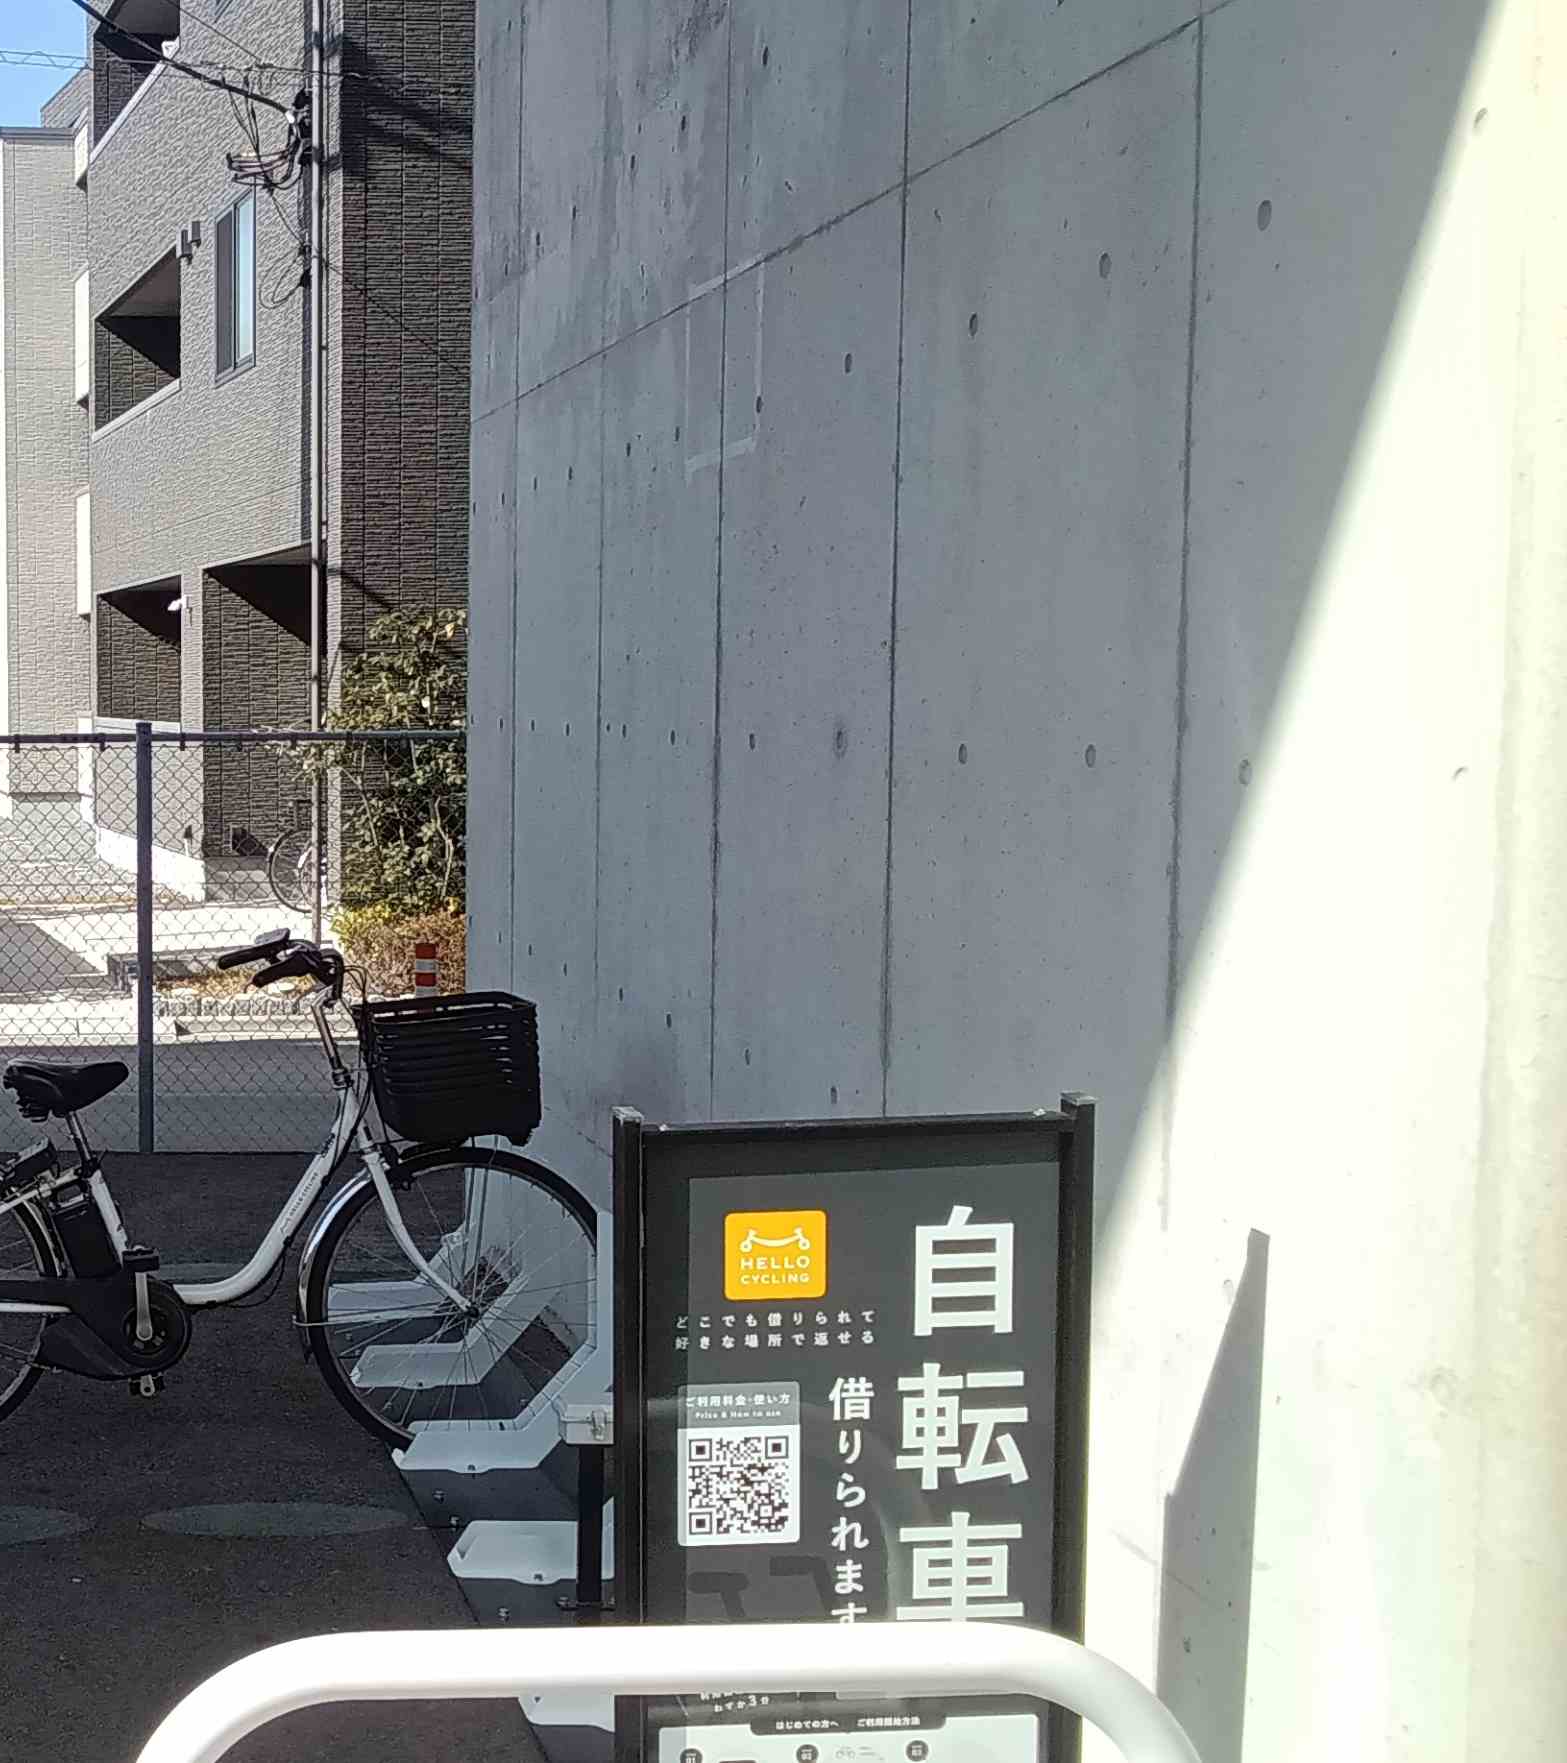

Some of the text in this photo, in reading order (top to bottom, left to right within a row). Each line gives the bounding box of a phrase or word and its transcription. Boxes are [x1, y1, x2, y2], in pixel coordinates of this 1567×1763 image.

[740, 1256, 811, 1270] HELLO
[740, 1273, 810, 1285] CYCLING
[676, 1310, 875, 1329] どこでも借りられて
[675, 1331, 875, 1350] 好きな場所で返せる
[895, 1205, 1029, 1621] 自転車
[828, 1376, 875, 1624] 借りられます
